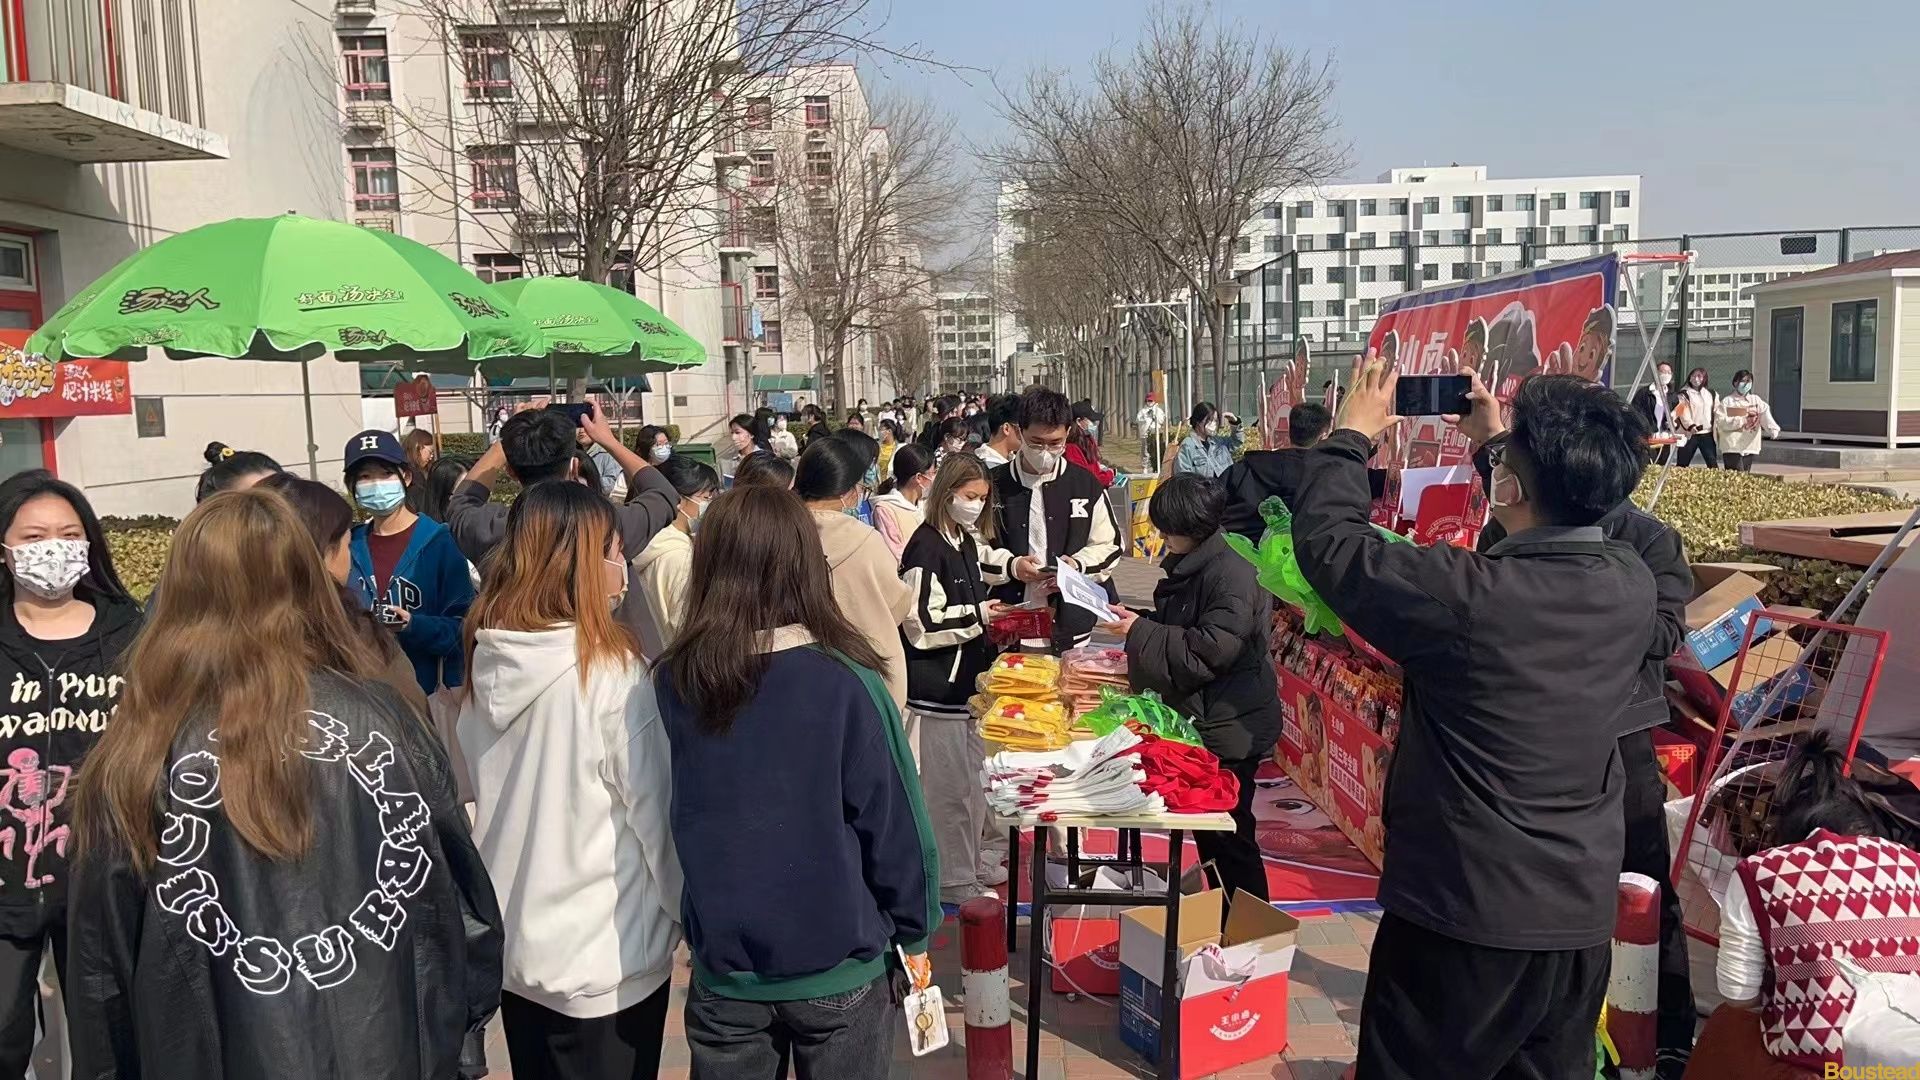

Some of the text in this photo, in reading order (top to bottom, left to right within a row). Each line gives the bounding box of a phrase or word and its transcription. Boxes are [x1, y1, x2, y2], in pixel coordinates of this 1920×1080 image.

[118, 286, 220, 315] 汤达人
[61, 380, 114, 402] 肥汁米线
[360, 435, 379, 450] H
[1070, 498, 1089, 518] K
[10, 672, 42, 703] in
